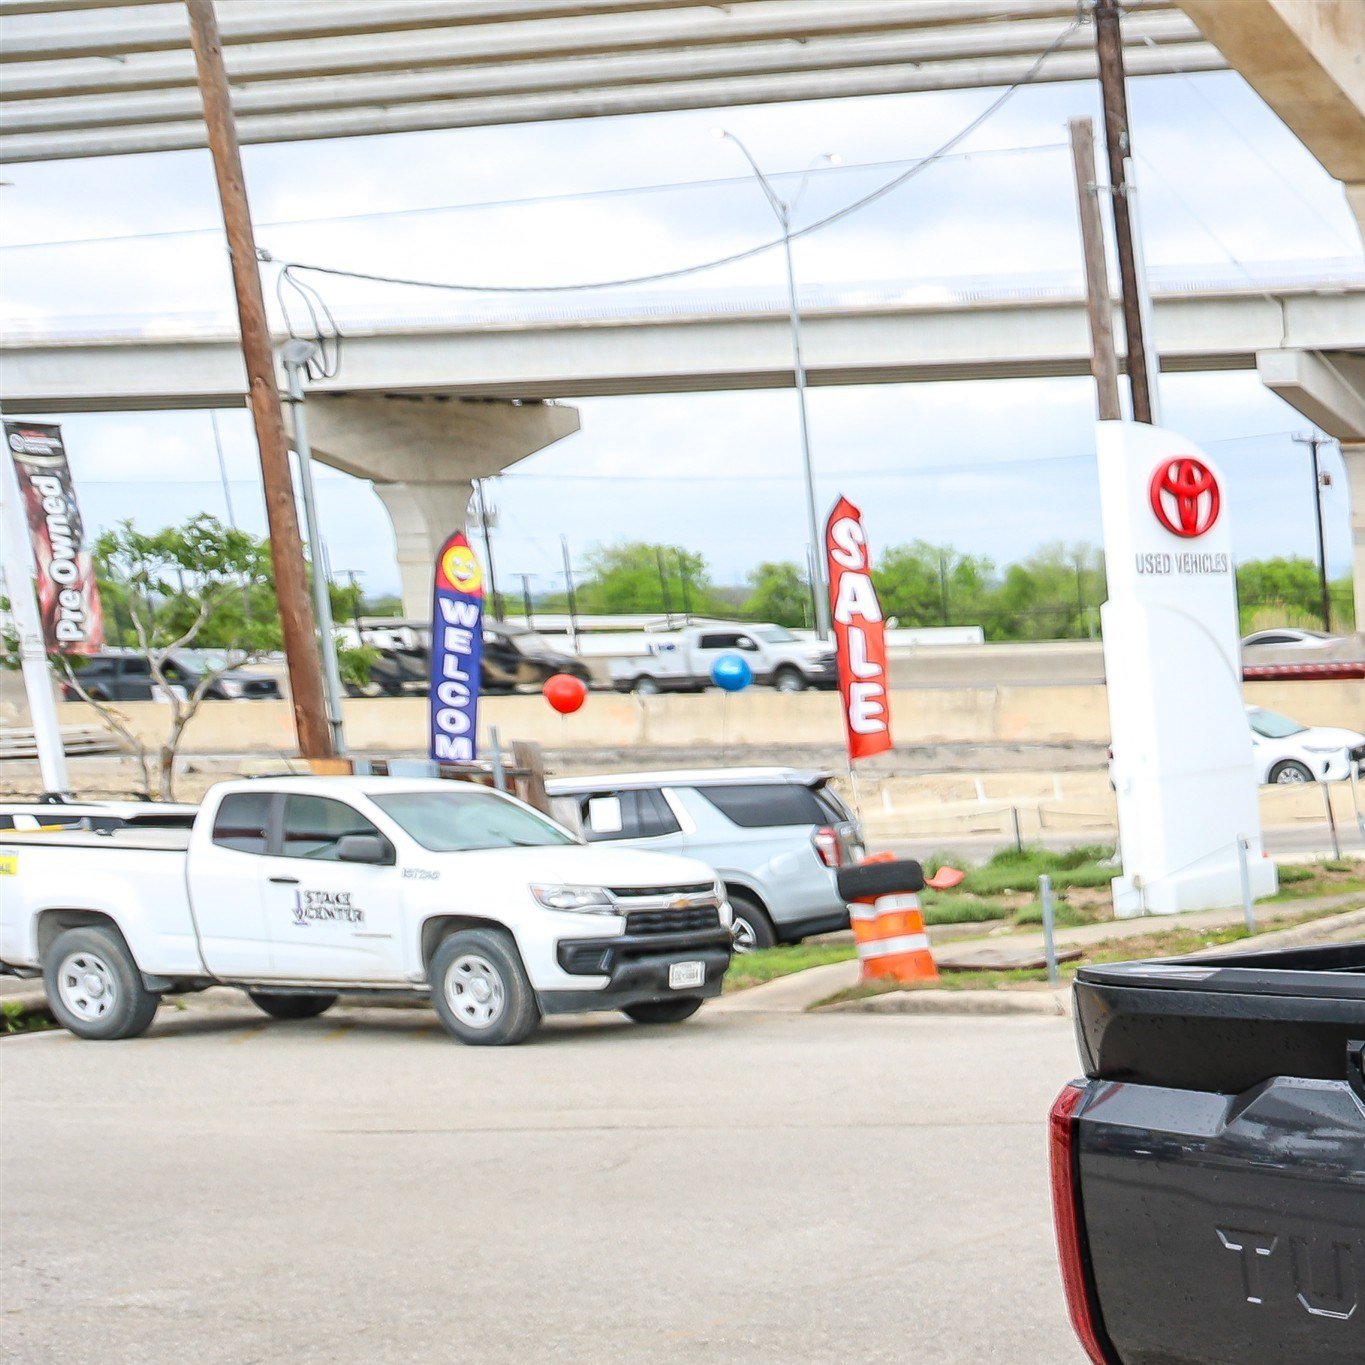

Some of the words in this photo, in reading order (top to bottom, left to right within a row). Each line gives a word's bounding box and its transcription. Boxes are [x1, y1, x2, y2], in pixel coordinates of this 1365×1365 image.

[29, 475, 79, 585] Owned
[1135, 553, 1171, 573] USED
[1175, 553, 1228, 573] VEHICLES
[56, 588, 85, 642] Pre
[830, 517, 887, 734] SALE
[435, 597, 479, 760] WELCOM
[305, 907, 364, 922] CENTER
